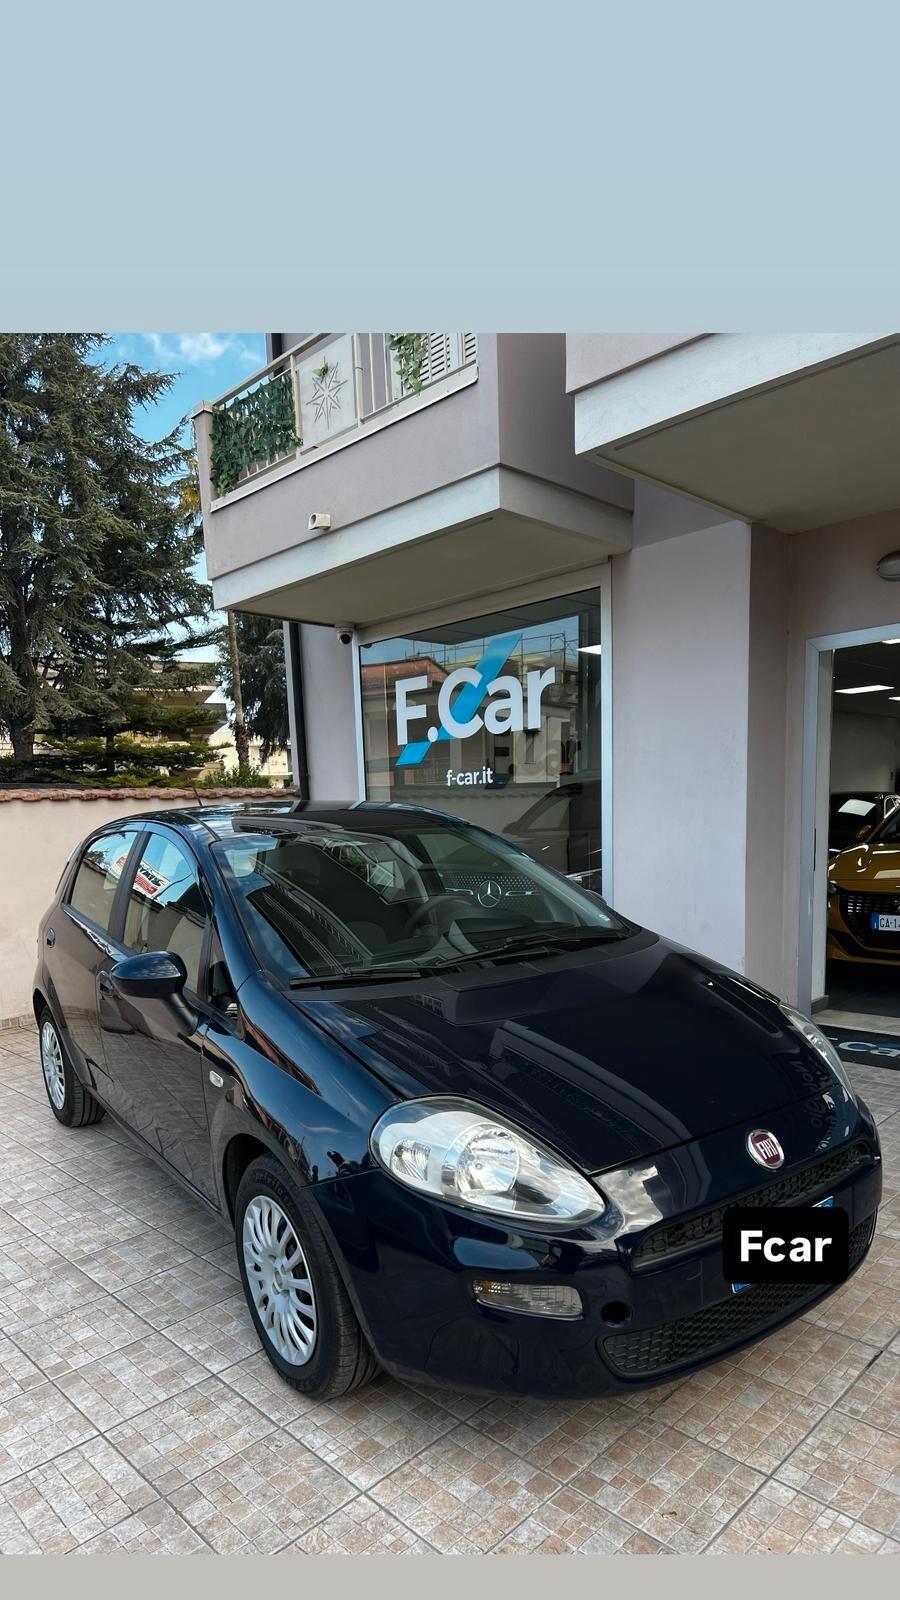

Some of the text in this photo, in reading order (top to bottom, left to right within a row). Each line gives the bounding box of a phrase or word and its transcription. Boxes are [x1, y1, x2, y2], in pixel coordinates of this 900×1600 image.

[395, 666, 556, 746] F.Car
[446, 766, 494, 786] f-car.it
[755, 1137, 779, 1160] FIAT
